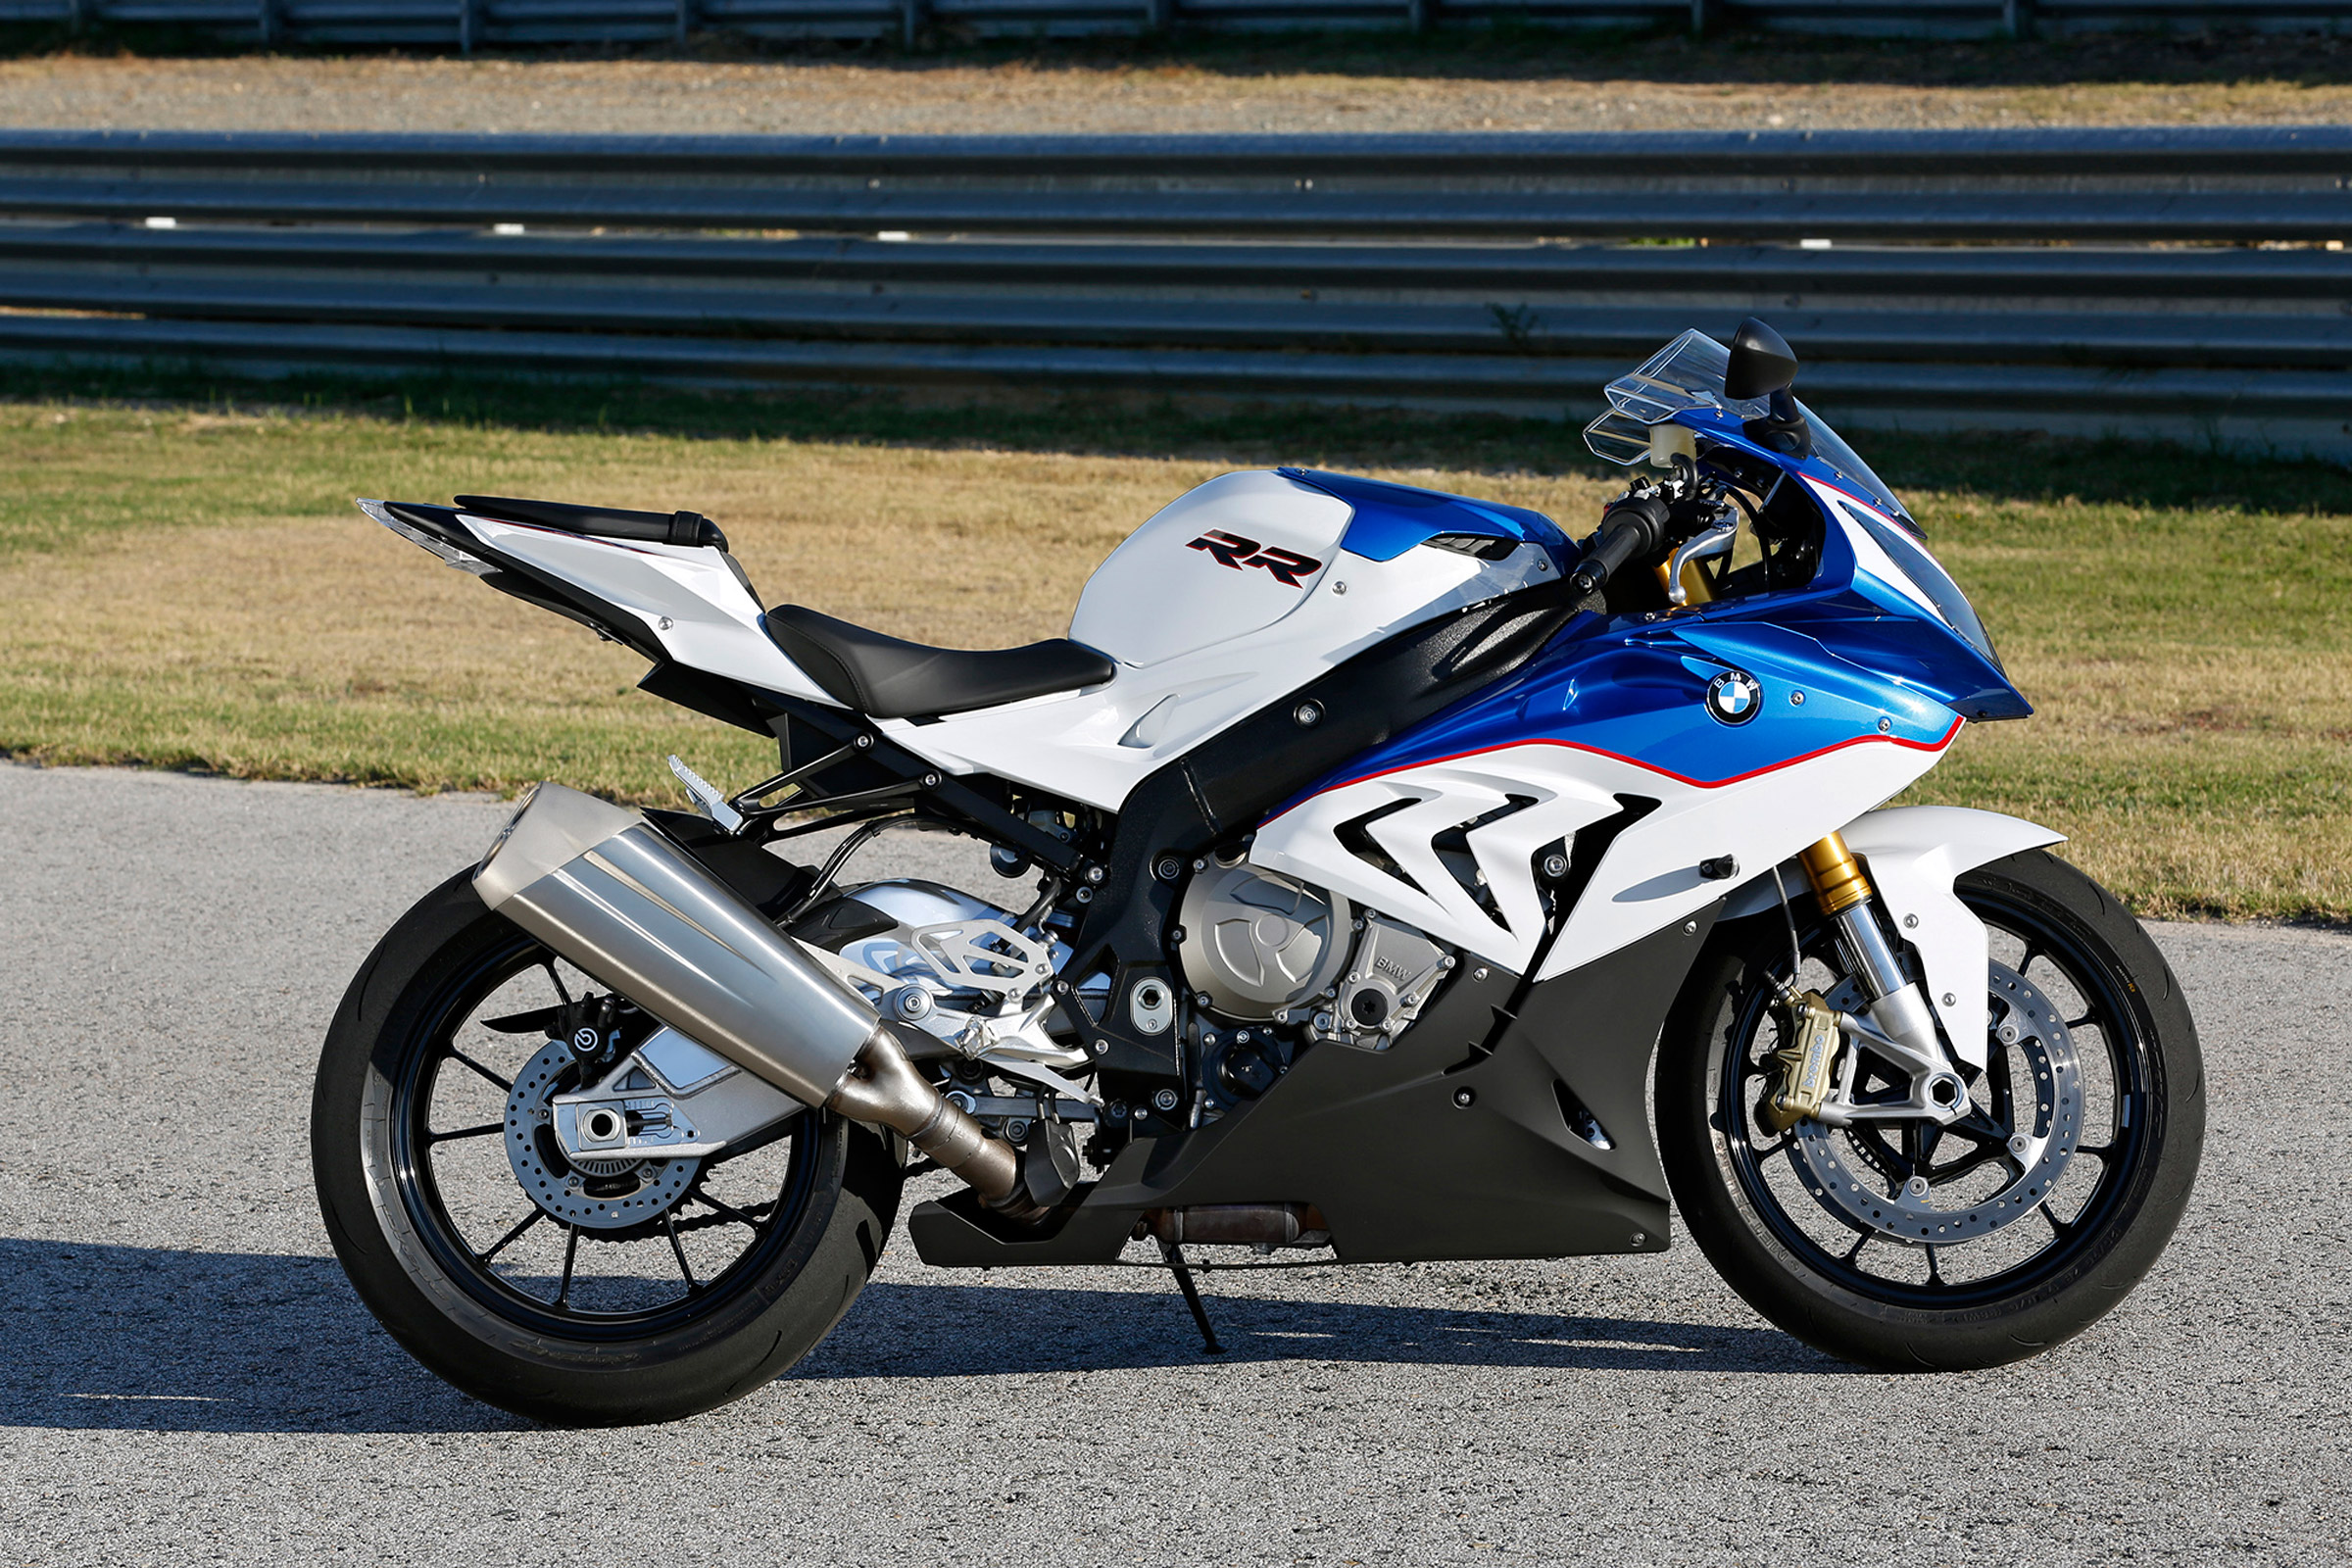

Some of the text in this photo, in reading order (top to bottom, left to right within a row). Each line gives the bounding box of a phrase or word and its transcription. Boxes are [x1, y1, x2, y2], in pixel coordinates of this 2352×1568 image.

[1185, 528, 1322, 589] RR
[1714, 672, 1760, 691] BMW
[1374, 956, 1411, 981] BMW
[1802, 1035, 1825, 1088] brembo
